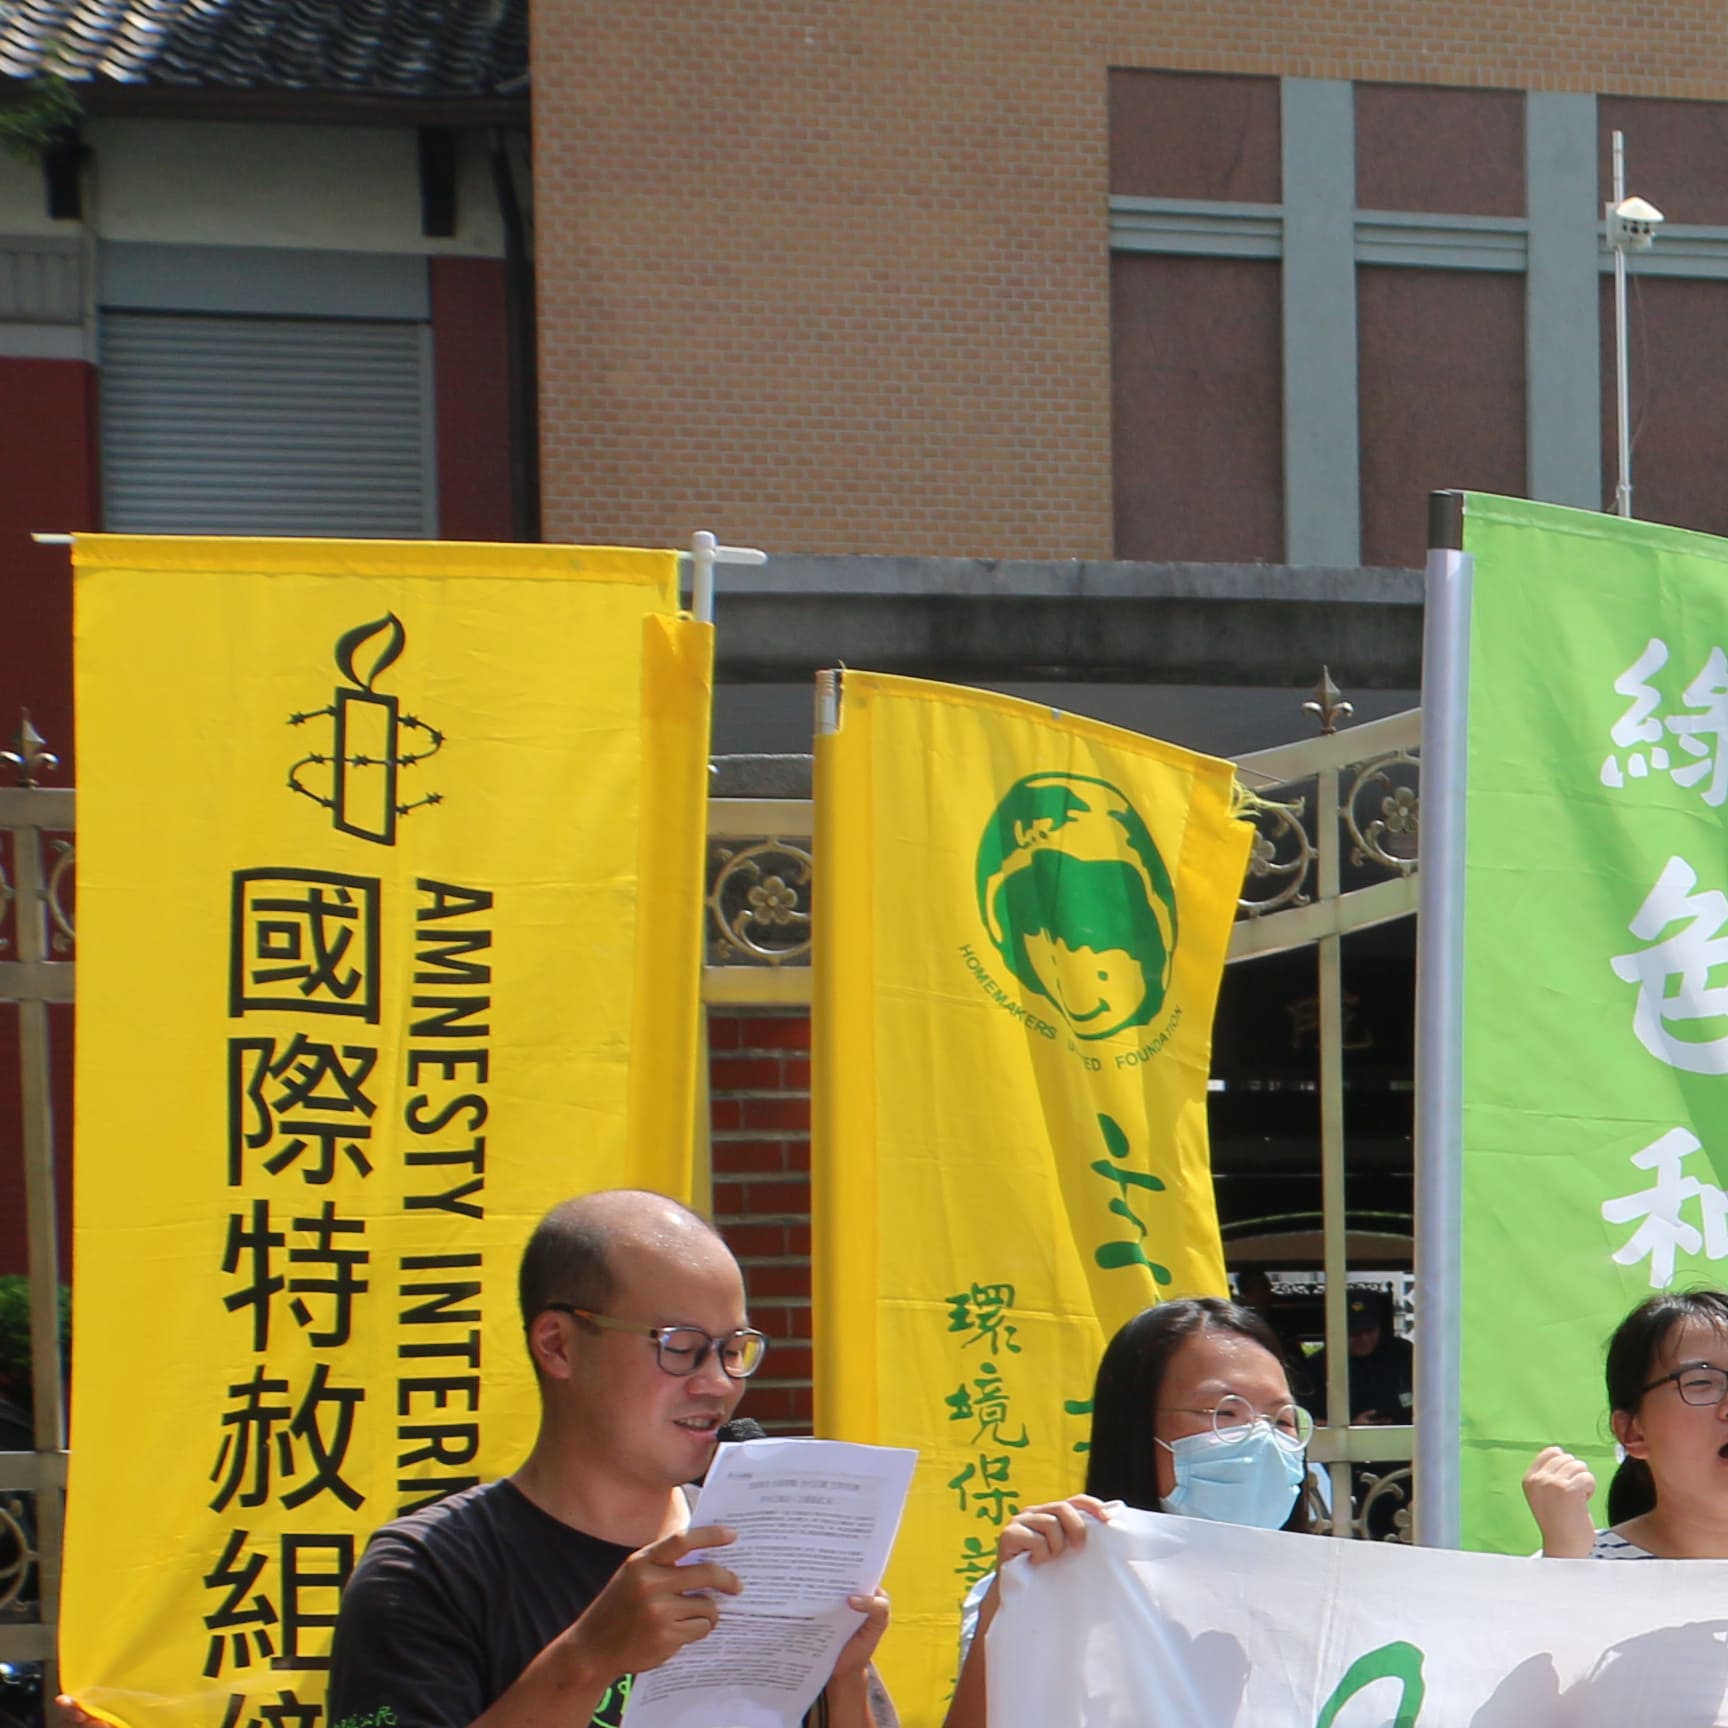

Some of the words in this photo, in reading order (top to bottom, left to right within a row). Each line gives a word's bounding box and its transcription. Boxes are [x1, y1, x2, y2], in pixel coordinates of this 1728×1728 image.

[403, 878, 495, 1221] AMNESTY
[958, 943, 1058, 1041] HOMEMAKERS
[1114, 1005, 1183, 1070] FOUNDATION
